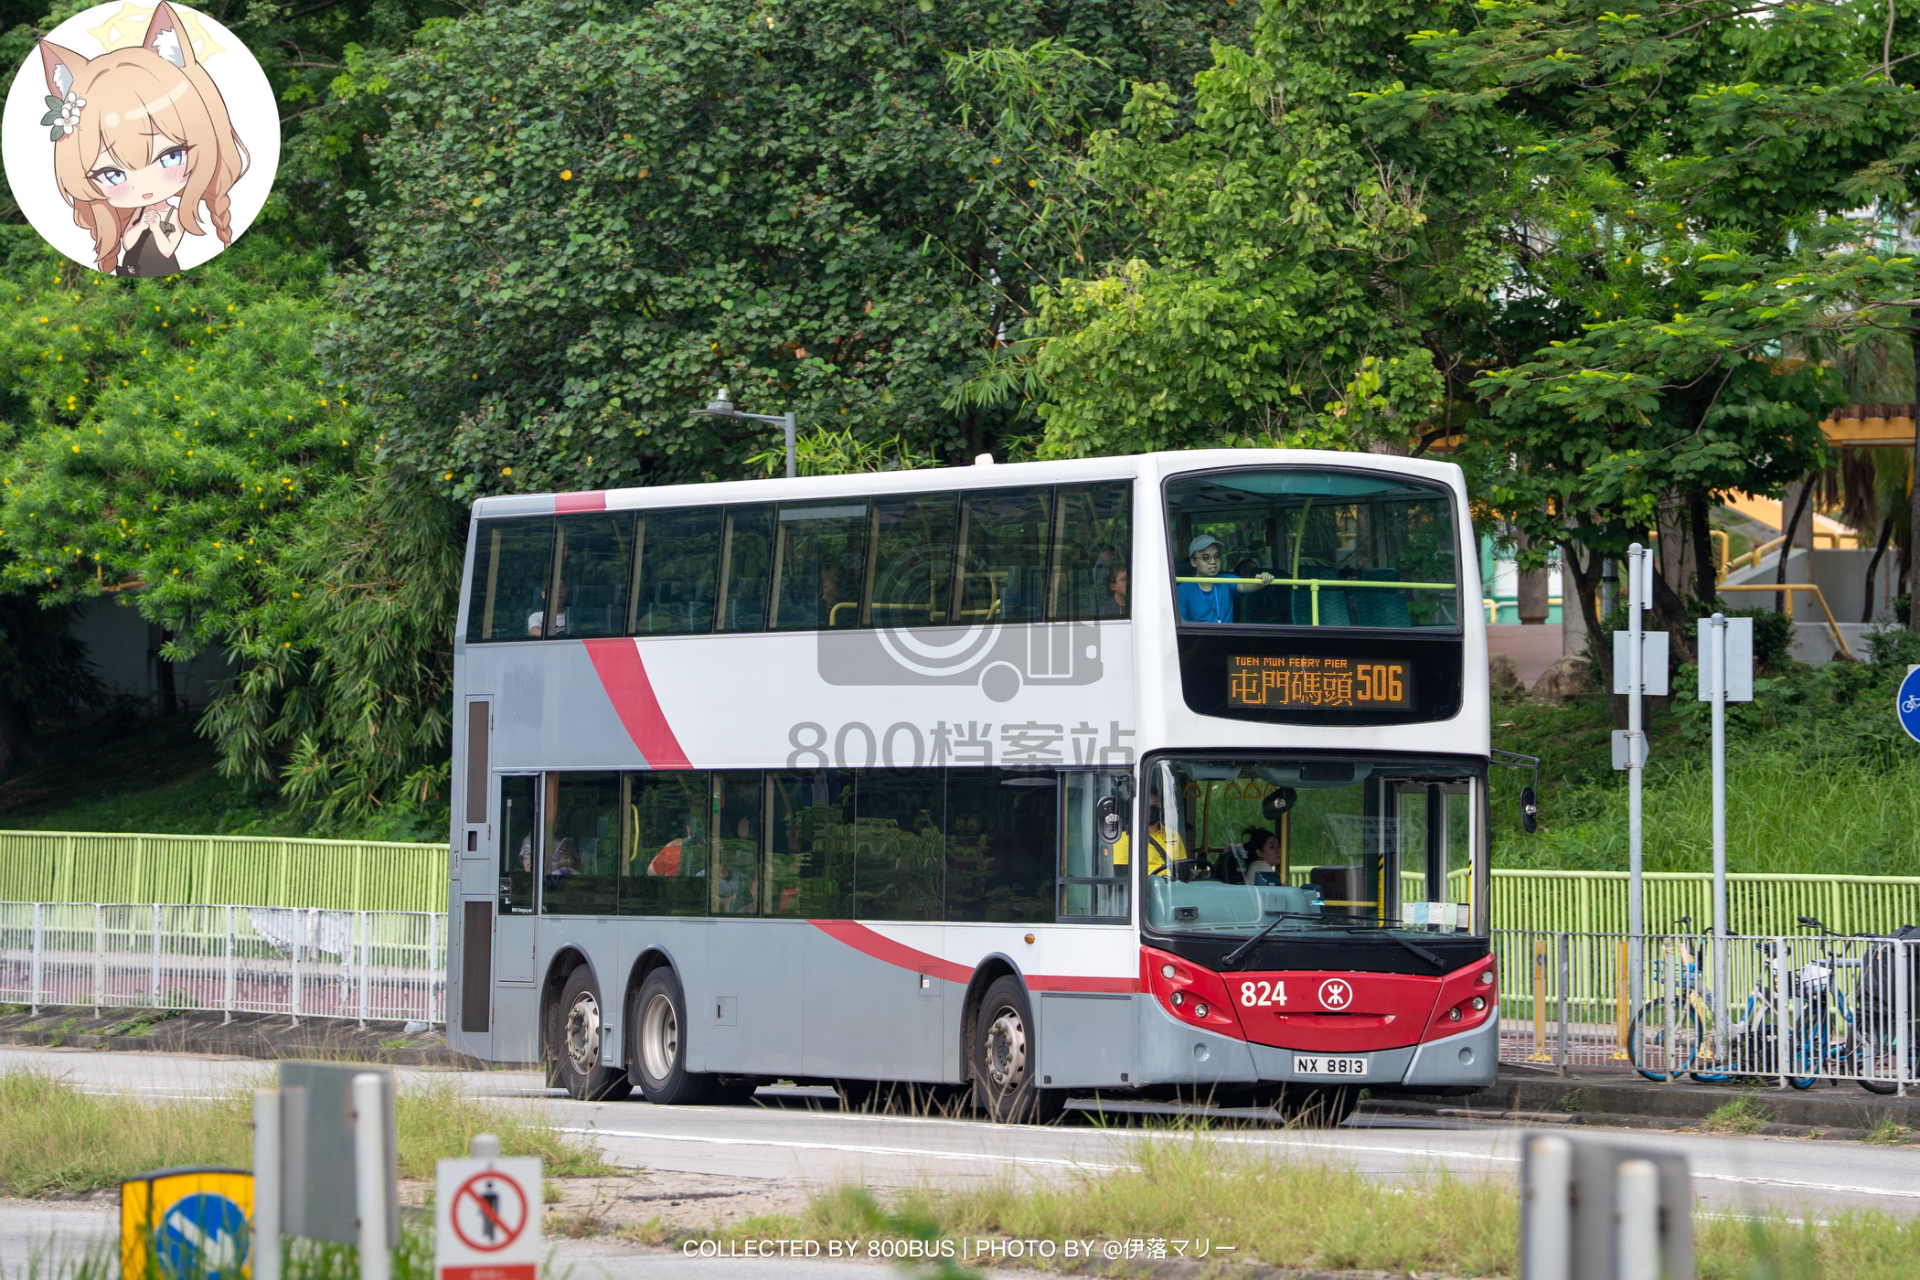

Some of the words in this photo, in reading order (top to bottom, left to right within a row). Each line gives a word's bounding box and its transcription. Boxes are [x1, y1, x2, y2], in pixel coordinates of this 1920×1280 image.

[1235, 656, 1260, 666] TUEN
[1263, 657, 1286, 667] MUN
[1289, 658, 1321, 667] FERRY
[1324, 659, 1348, 668] PIER
[1230, 669, 1353, 706] 屯門碼頭
[1357, 664, 1403, 702] 506
[1241, 981, 1288, 1007] 824
[1298, 1059, 1318, 1072] NX
[1327, 1059, 1363, 1073] 8813
